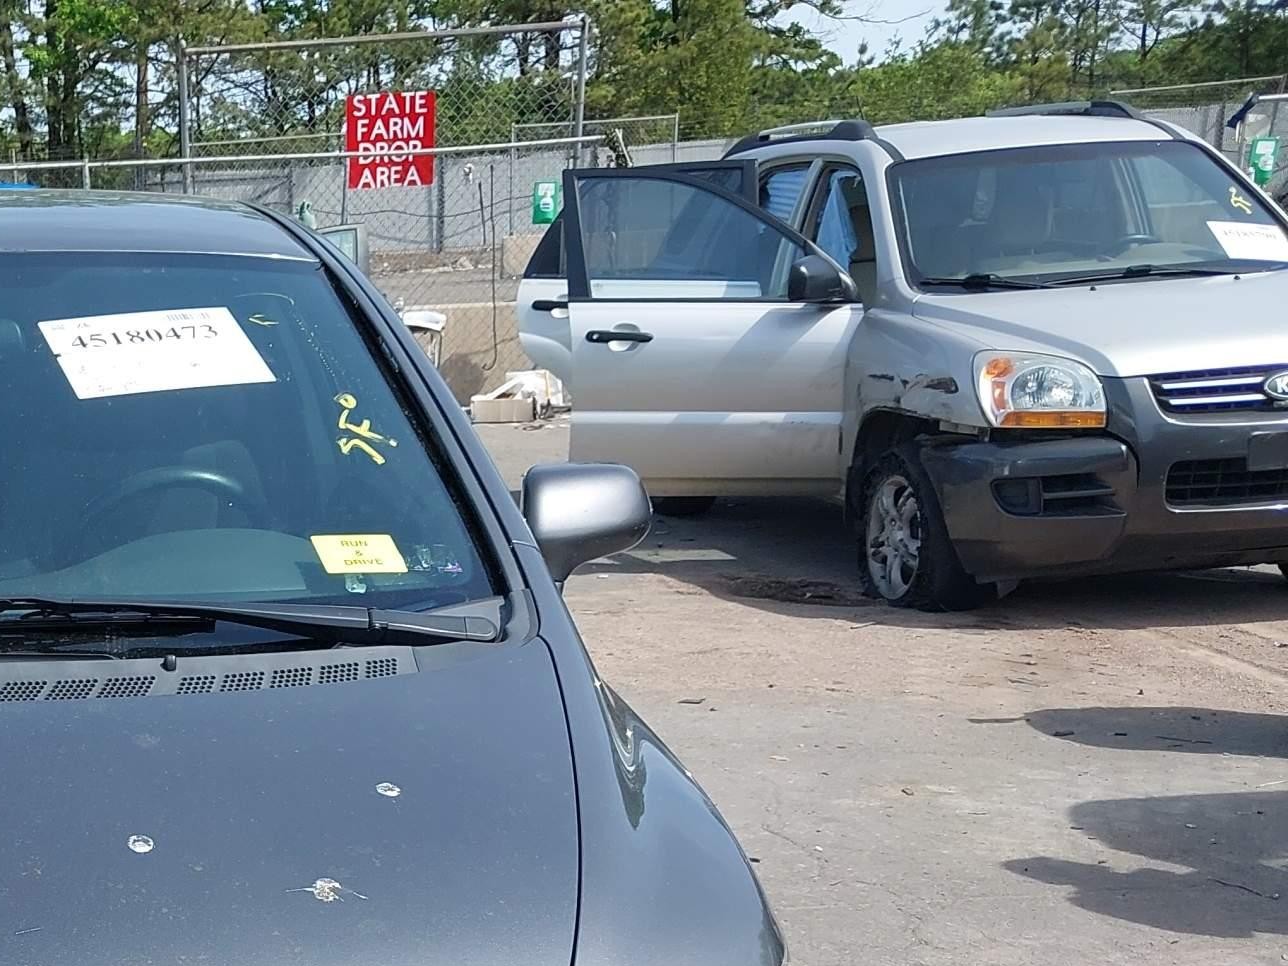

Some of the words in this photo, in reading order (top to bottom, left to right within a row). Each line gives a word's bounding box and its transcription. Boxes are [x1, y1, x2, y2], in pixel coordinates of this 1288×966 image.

[353, 91, 428, 117] STATE
[356, 116, 425, 142] FARM
[358, 140, 423, 165] DROP
[357, 165, 422, 190] AREA
[71, 324, 218, 349] 45180473
